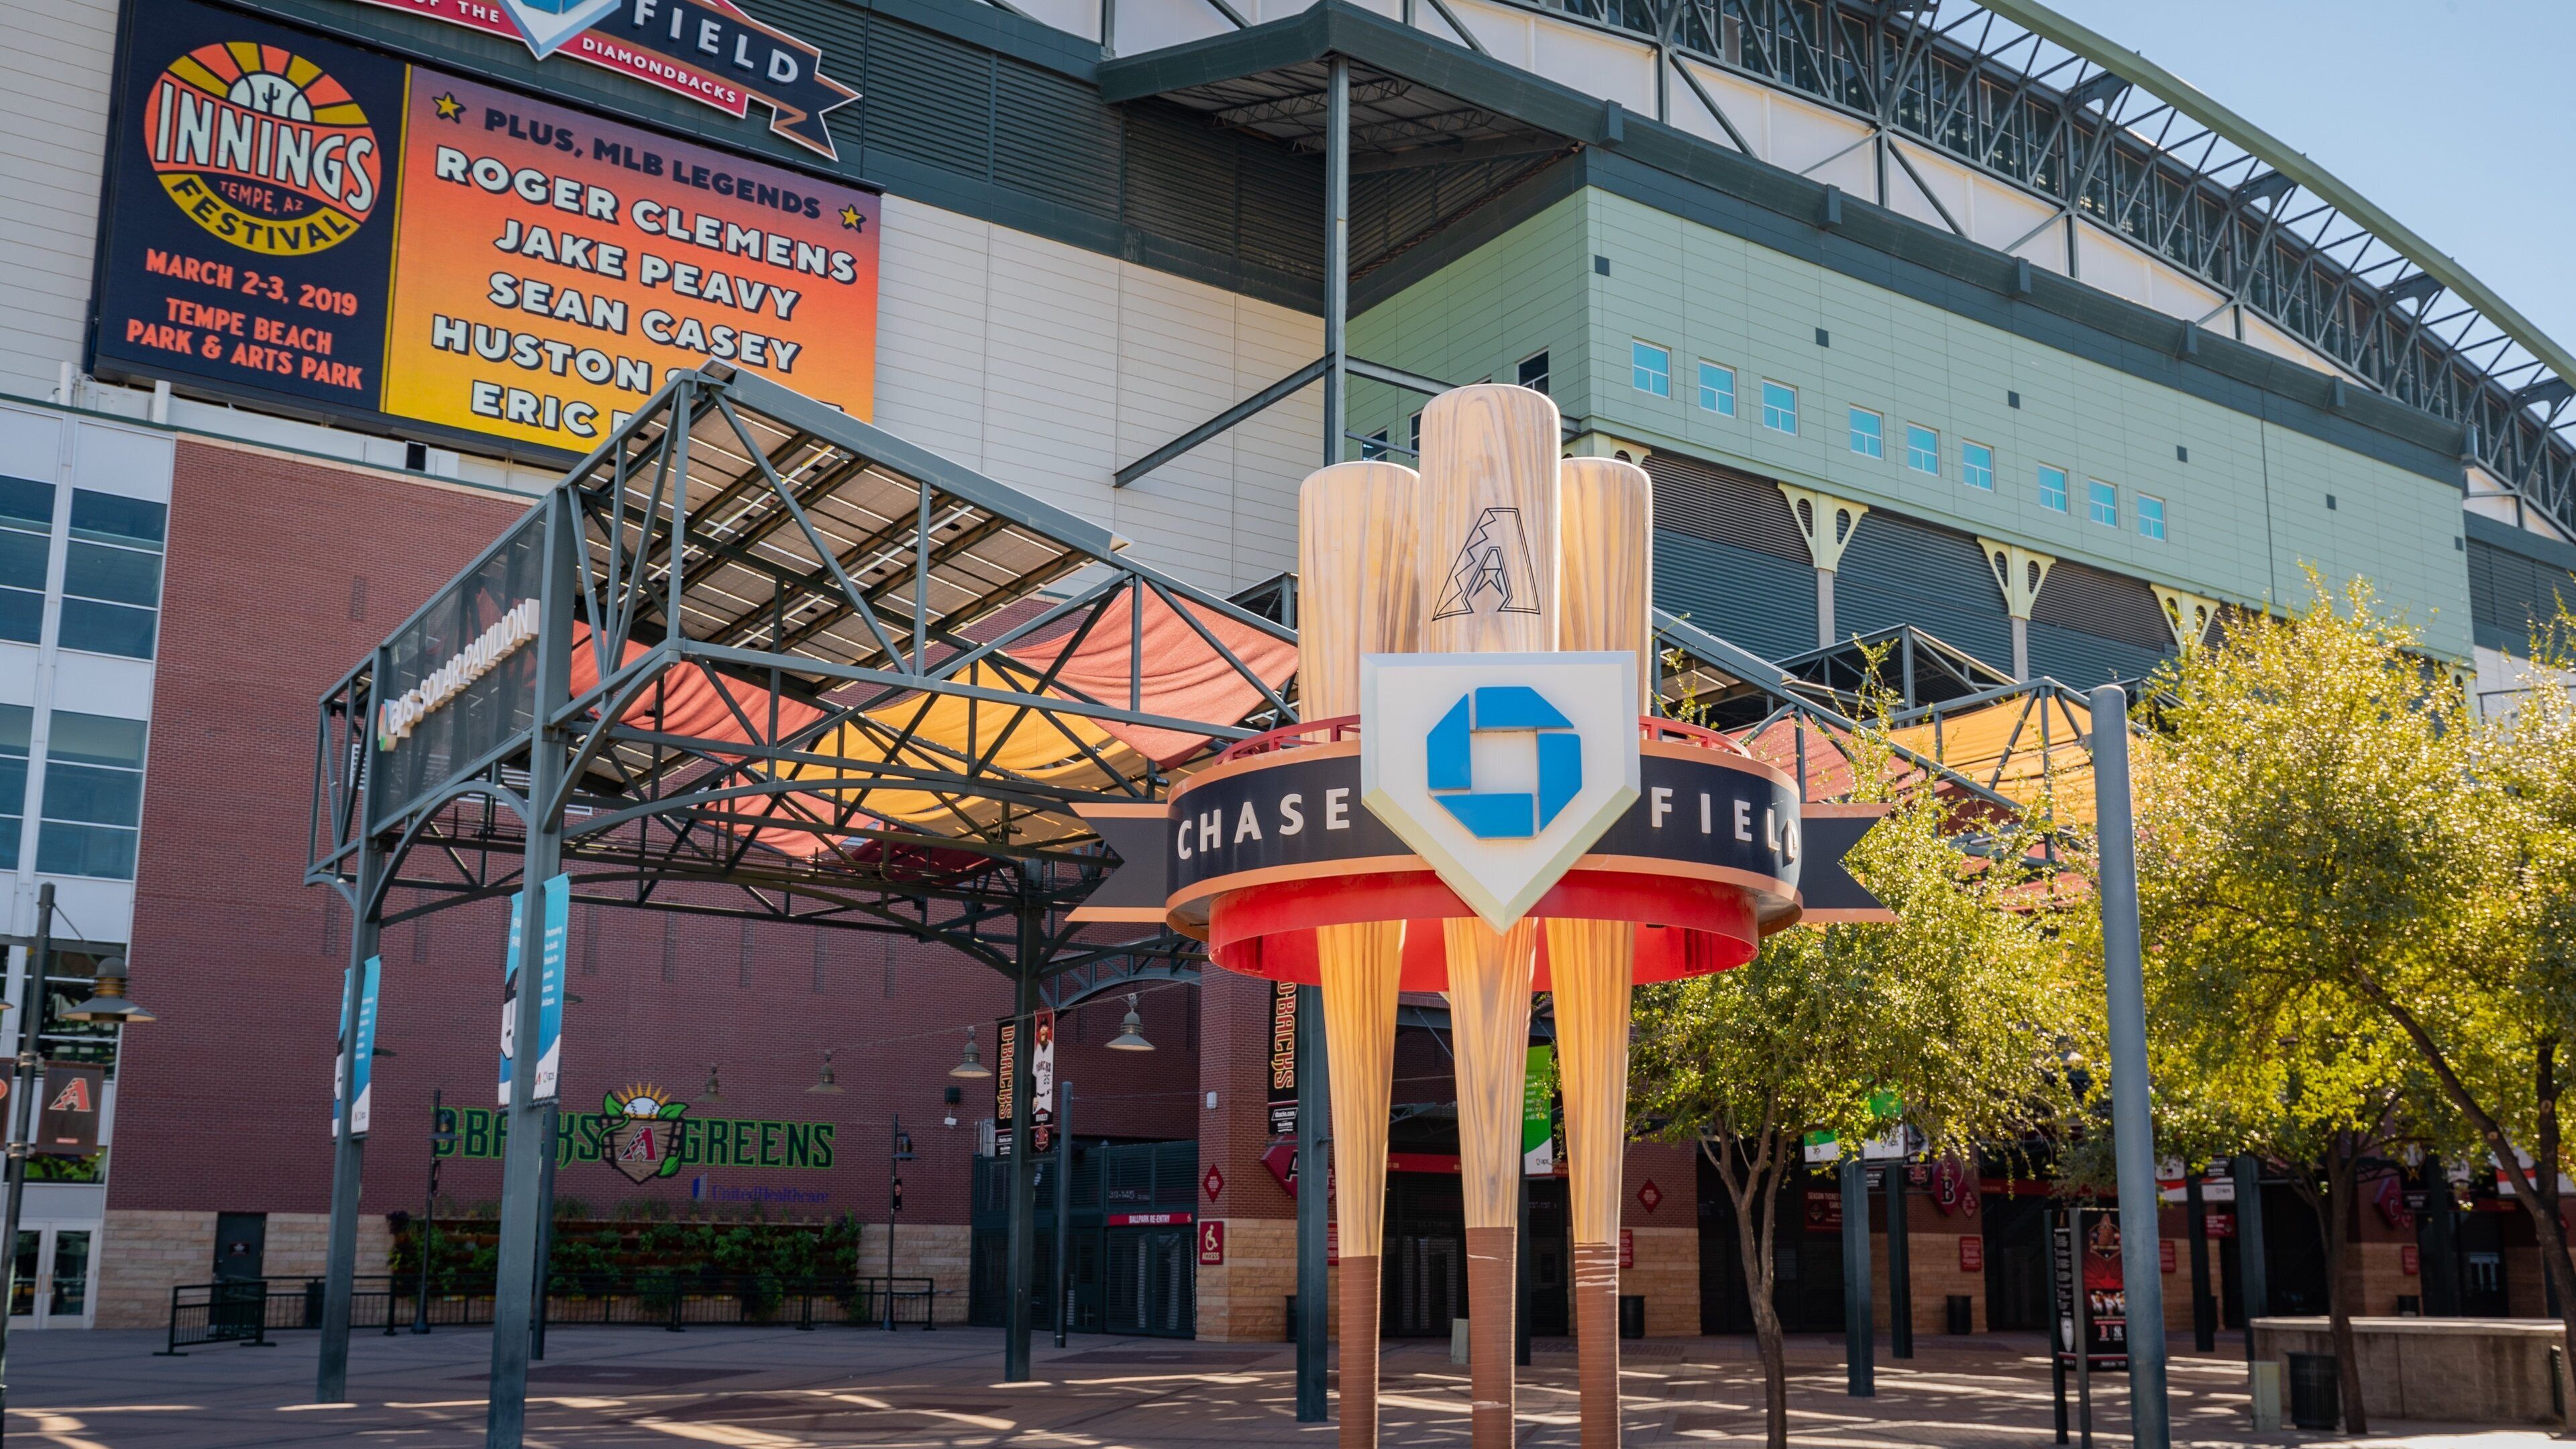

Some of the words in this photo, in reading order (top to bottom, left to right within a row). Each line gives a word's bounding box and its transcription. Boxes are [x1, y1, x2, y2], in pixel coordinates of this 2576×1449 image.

[458, 1, 499, 23] THE
[582, 37, 737, 104] DIAMONDBACKS
[633, 0, 799, 85] FIELD
[155, 78, 374, 213] INNINGS
[484, 107, 584, 158] PLUS,
[593, 138, 663, 176] MLB
[672, 160, 820, 219] LEGENDS
[171, 176, 351, 250] FESTIVAL
[219, 180, 278, 215] TEMPE,
[283, 199, 303, 212] AZ
[435, 144, 621, 225] ROGER
[631, 199, 857, 284] CLEMENS
[145, 248, 234, 290] MARCH
[241, 270, 290, 304] 2-3,
[299, 284, 358, 317] 2019
[492, 217, 628, 282] JAKE
[640, 252, 802, 322] PEAVY
[126, 318, 193, 355] PARK
[201, 335, 223, 360] &
[230, 342, 294, 375] ARTS
[301, 356, 364, 390] PARK
[166, 297, 246, 337] TEMPE
[254, 317, 333, 356] BEACH
[431, 313, 653, 396] HUSTON
[487, 271, 629, 336] SEAN
[641, 309, 803, 374] CASEY
[471, 379, 600, 438] ERIC
[390, 689, 424, 738] aps
[420, 653, 471, 712] SOLAR
[464, 598, 540, 680] PAVILION
[1177, 788, 1350, 860] CHASE
[1651, 786, 1800, 860] FIELD
[681, 1117, 835, 1169] GREENS
[1129, 1215, 1149, 1224] BALLPARK
[1149, 1214, 1171, 1223] RE-ENTRY
[1201, 1252, 1220, 1260] ACCESS
